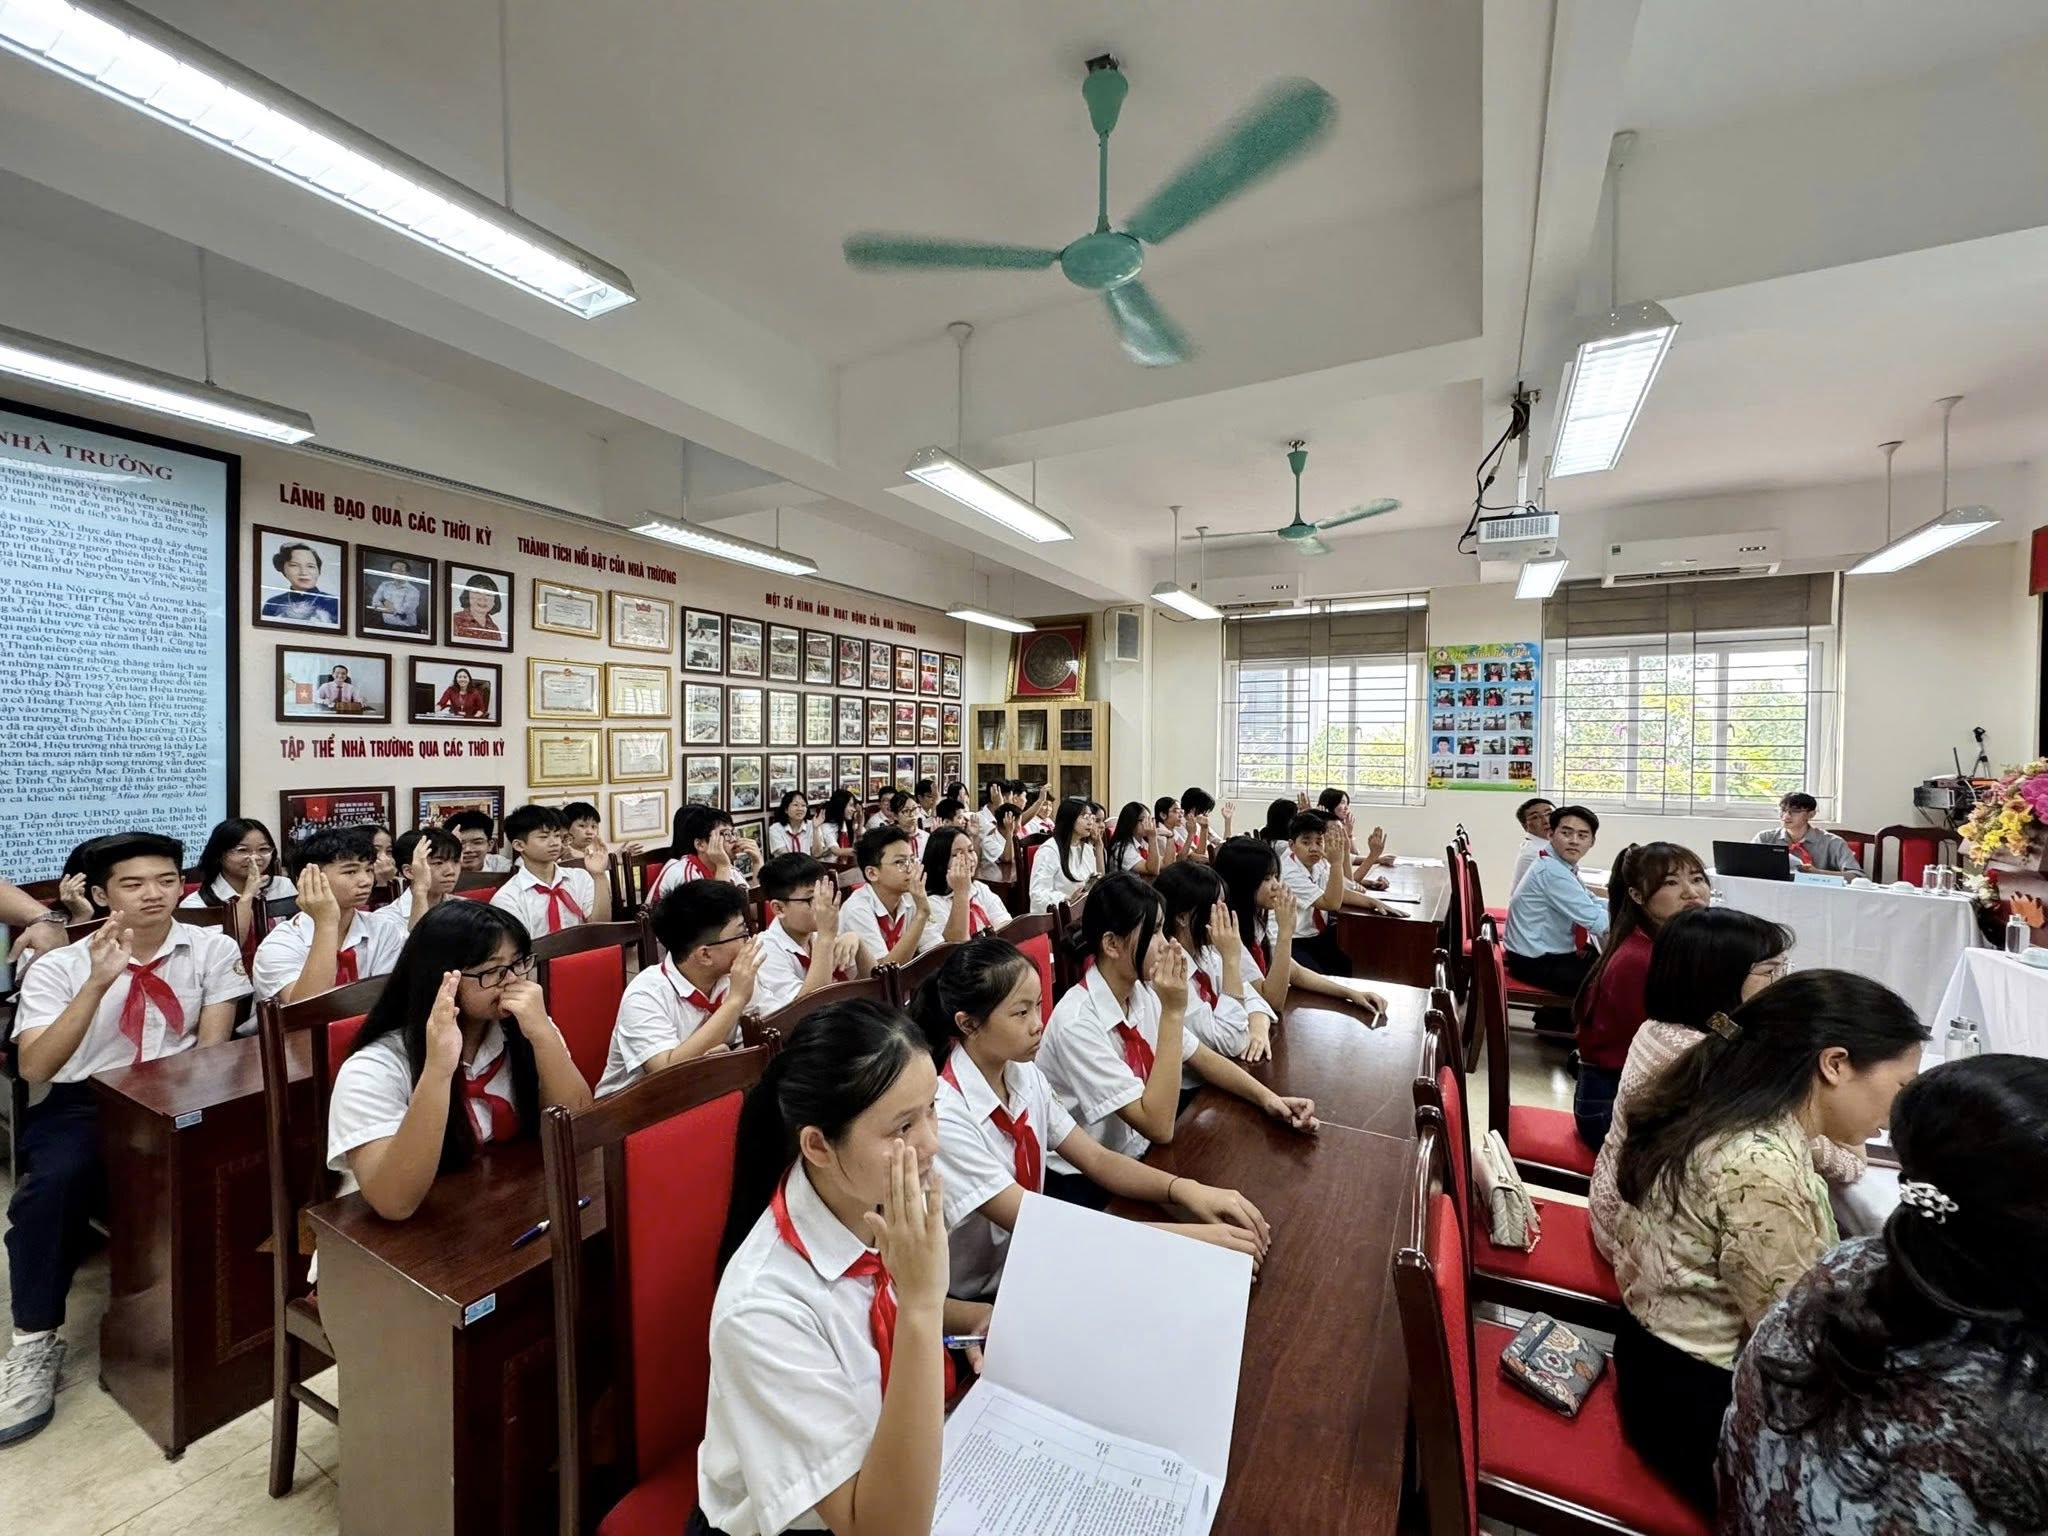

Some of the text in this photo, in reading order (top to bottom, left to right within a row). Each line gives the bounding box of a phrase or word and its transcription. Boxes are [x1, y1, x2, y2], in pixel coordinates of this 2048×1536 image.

[279, 481, 492, 546] LÃNH ĐẠO QUA CÁC THỜI KỲ
[82, 551, 102, 560] học
[517, 535, 550, 559] THÀNH
[552, 543, 572, 564] TÍCH
[574, 545, 589, 567] NỔI
[591, 552, 608, 573] BẬT
[609, 554, 625, 574] CỦA
[627, 560, 645, 578] NHÀ
[20, 560, 48, 570] Nam
[68, 593, 100, 603] THPT
[102, 597, 124, 606] Chu
[765, 591, 781, 609] MỘT
[39, 616, 61, 625] khu
[5, 640, 42, 650] Thanh
[10, 677, 25, 685] do
[8, 740, 42, 749] 2004,
[280, 733, 505, 761] TẬP THỂ NHÀ TRƯỜNG QUA CÁC THỜI KỲ
[83, 809, 120, 817] UBND
